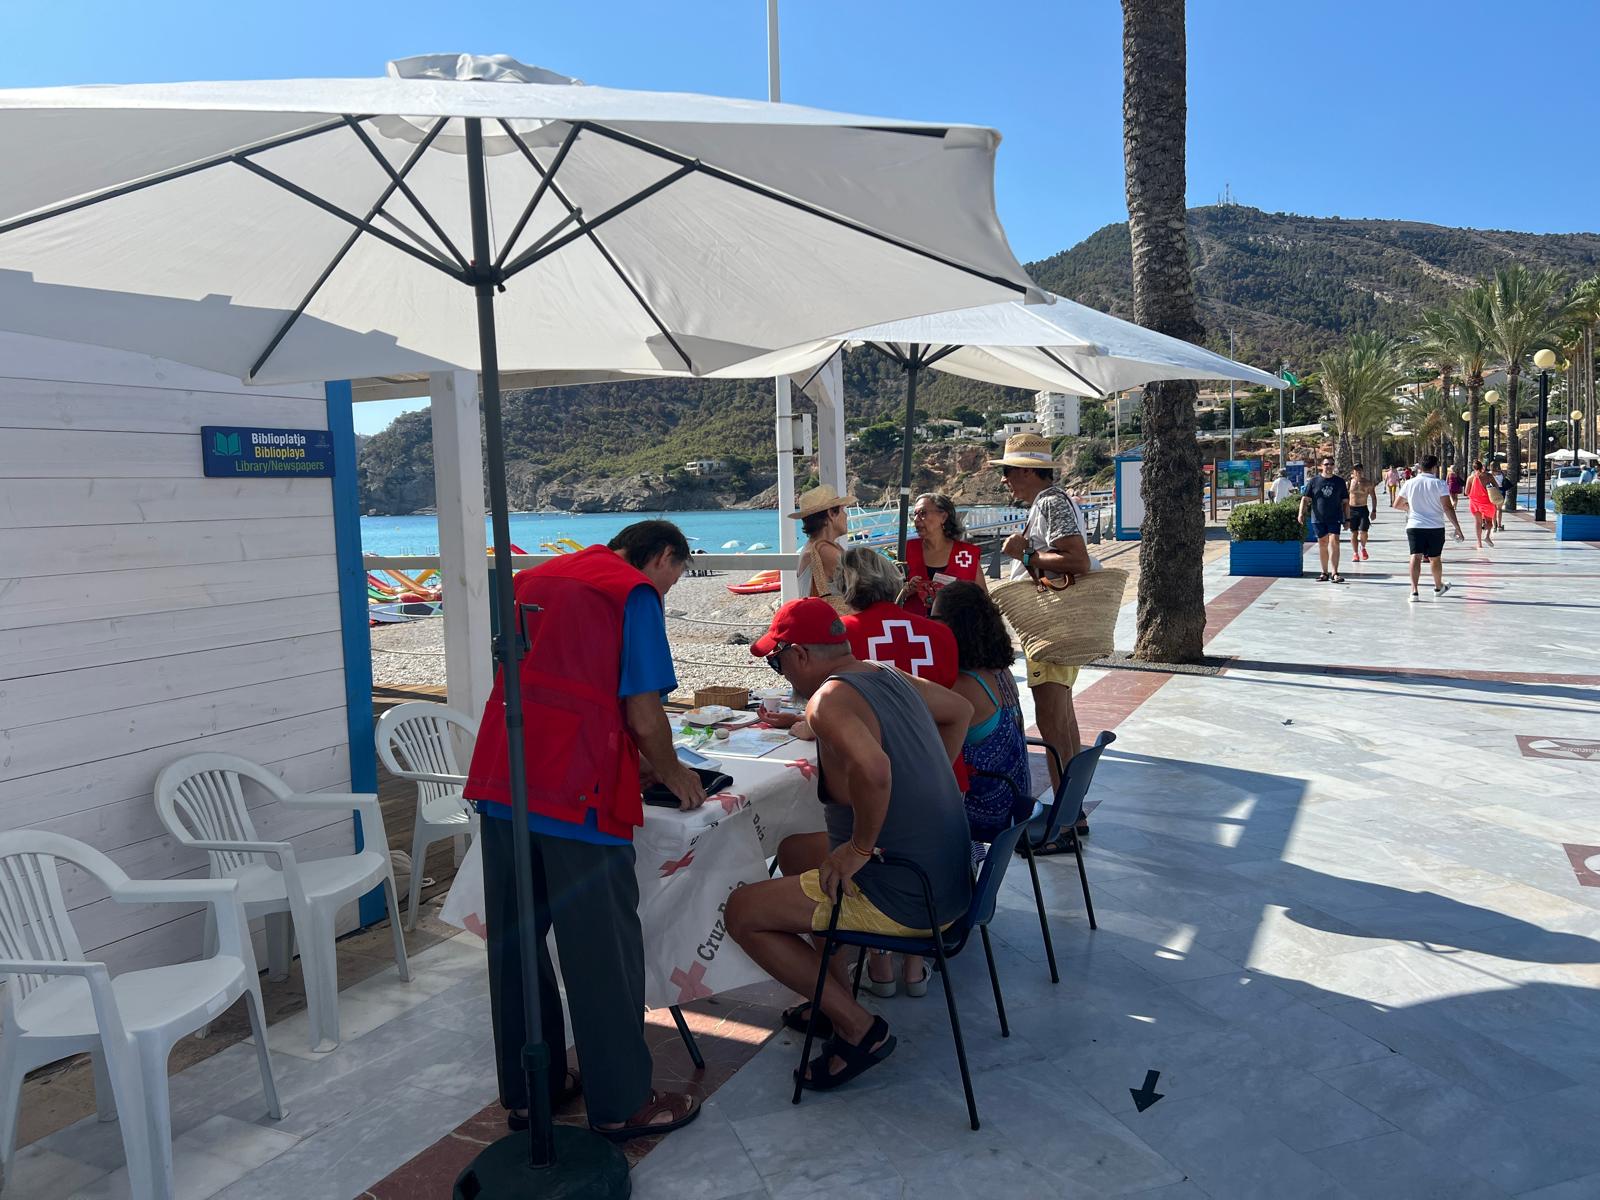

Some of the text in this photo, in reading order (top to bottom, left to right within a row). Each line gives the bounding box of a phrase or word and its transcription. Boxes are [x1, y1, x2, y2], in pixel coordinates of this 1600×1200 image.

[251, 432, 306, 446] Biblioplatja
[255, 446, 305, 460] Biblioplaya
[235, 460, 325, 473] Library/Newspapers
